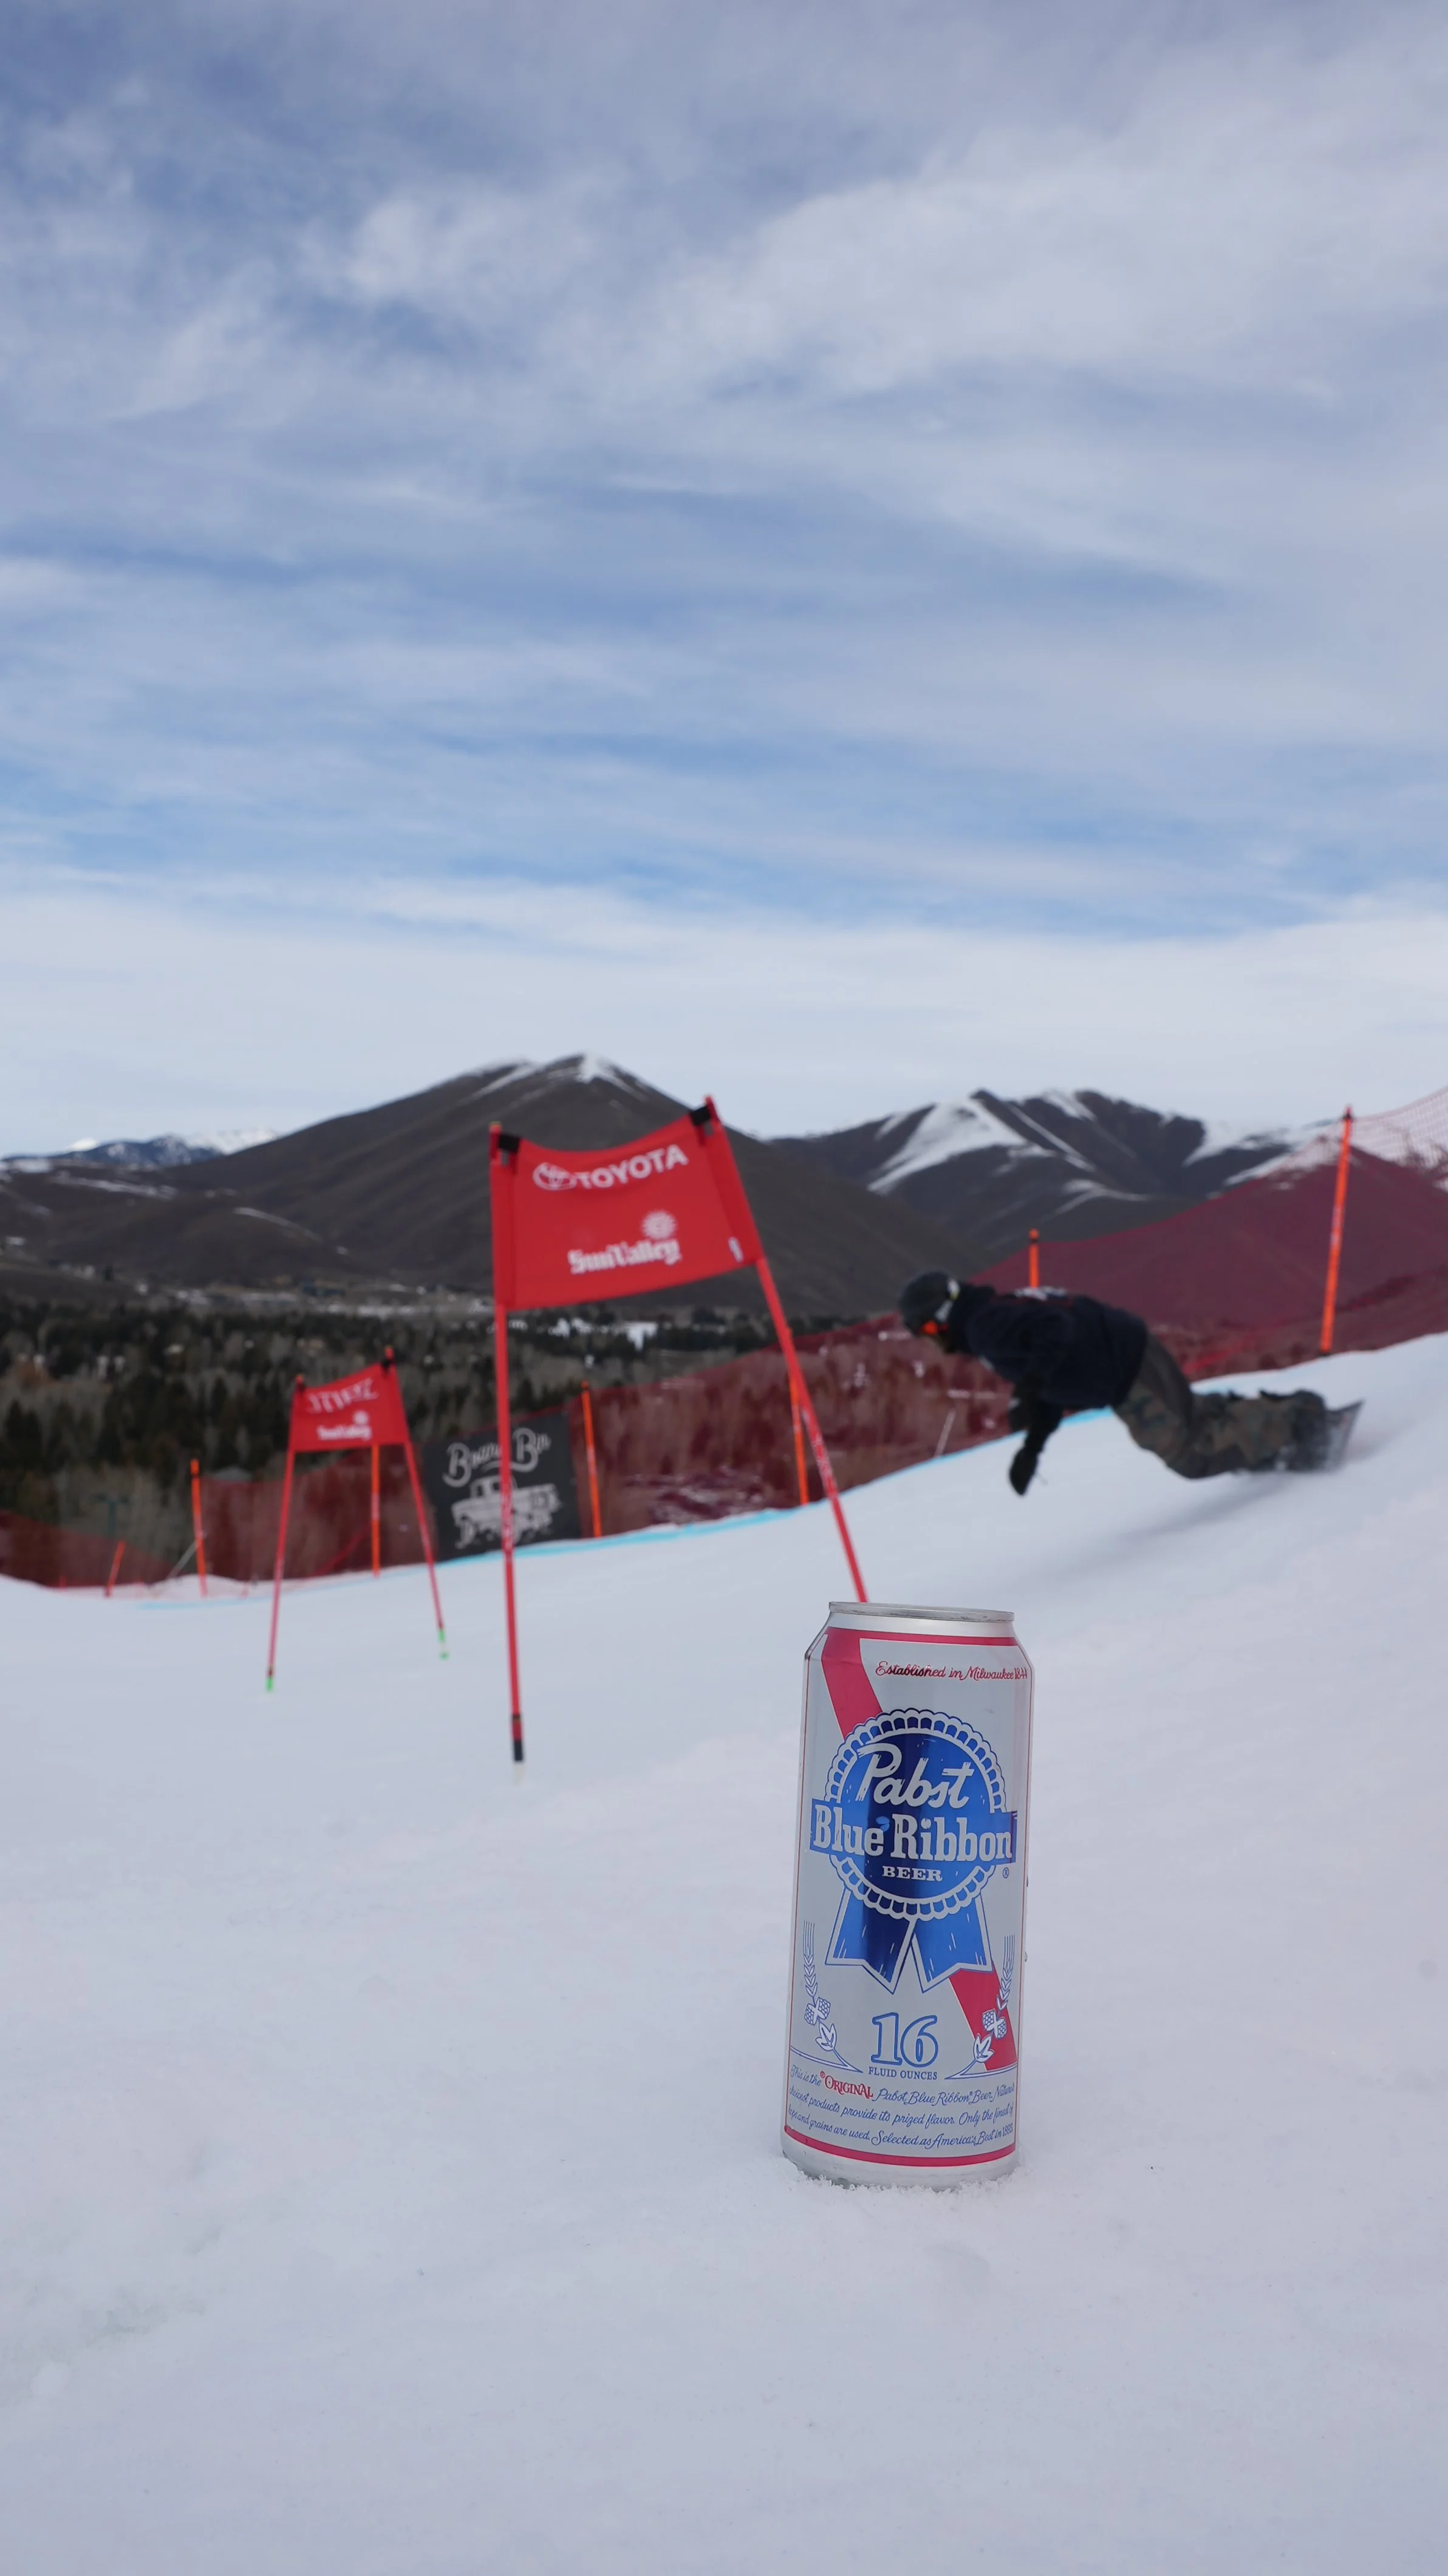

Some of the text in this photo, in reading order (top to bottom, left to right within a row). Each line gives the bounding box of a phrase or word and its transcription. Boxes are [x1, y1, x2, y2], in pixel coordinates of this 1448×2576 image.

[576, 1145, 688, 1189] TOYOTA
[875, 1661, 1028, 1680] Established in Milwaukee 1844
[856, 1742, 975, 1809] Pabst
[813, 1804, 1013, 1862] Blue Ribbon
[882, 1865, 943, 1882] BEER
[870, 2012, 938, 2067] 16
[869, 2066, 938, 2080] FLUID OUNCES
[808, 2073, 821, 2086] the
[825, 2075, 873, 2099] ORIGINAL
[872, 2088, 907, 2102] Pabst
[903, 2091, 935, 2105] Blue
[797, 2114, 810, 2124] and
[808, 2097, 840, 2113] products
[841, 2106, 878, 2120] provide
[878, 2110, 891, 2122] its
[892, 2113, 926, 2128] prized
[958, 2110, 980, 2127] Only
[982, 2109, 993, 2121] the
[810, 2120, 833, 2132] grains
[833, 2127, 848, 2136] are
[994, 2129, 1002, 2139] in
[871, 2130, 919, 2146] Selected
[918, 2137, 932, 2146] as
[924, 2132, 976, 2150] America's
[974, 2129, 995, 2146] Best
